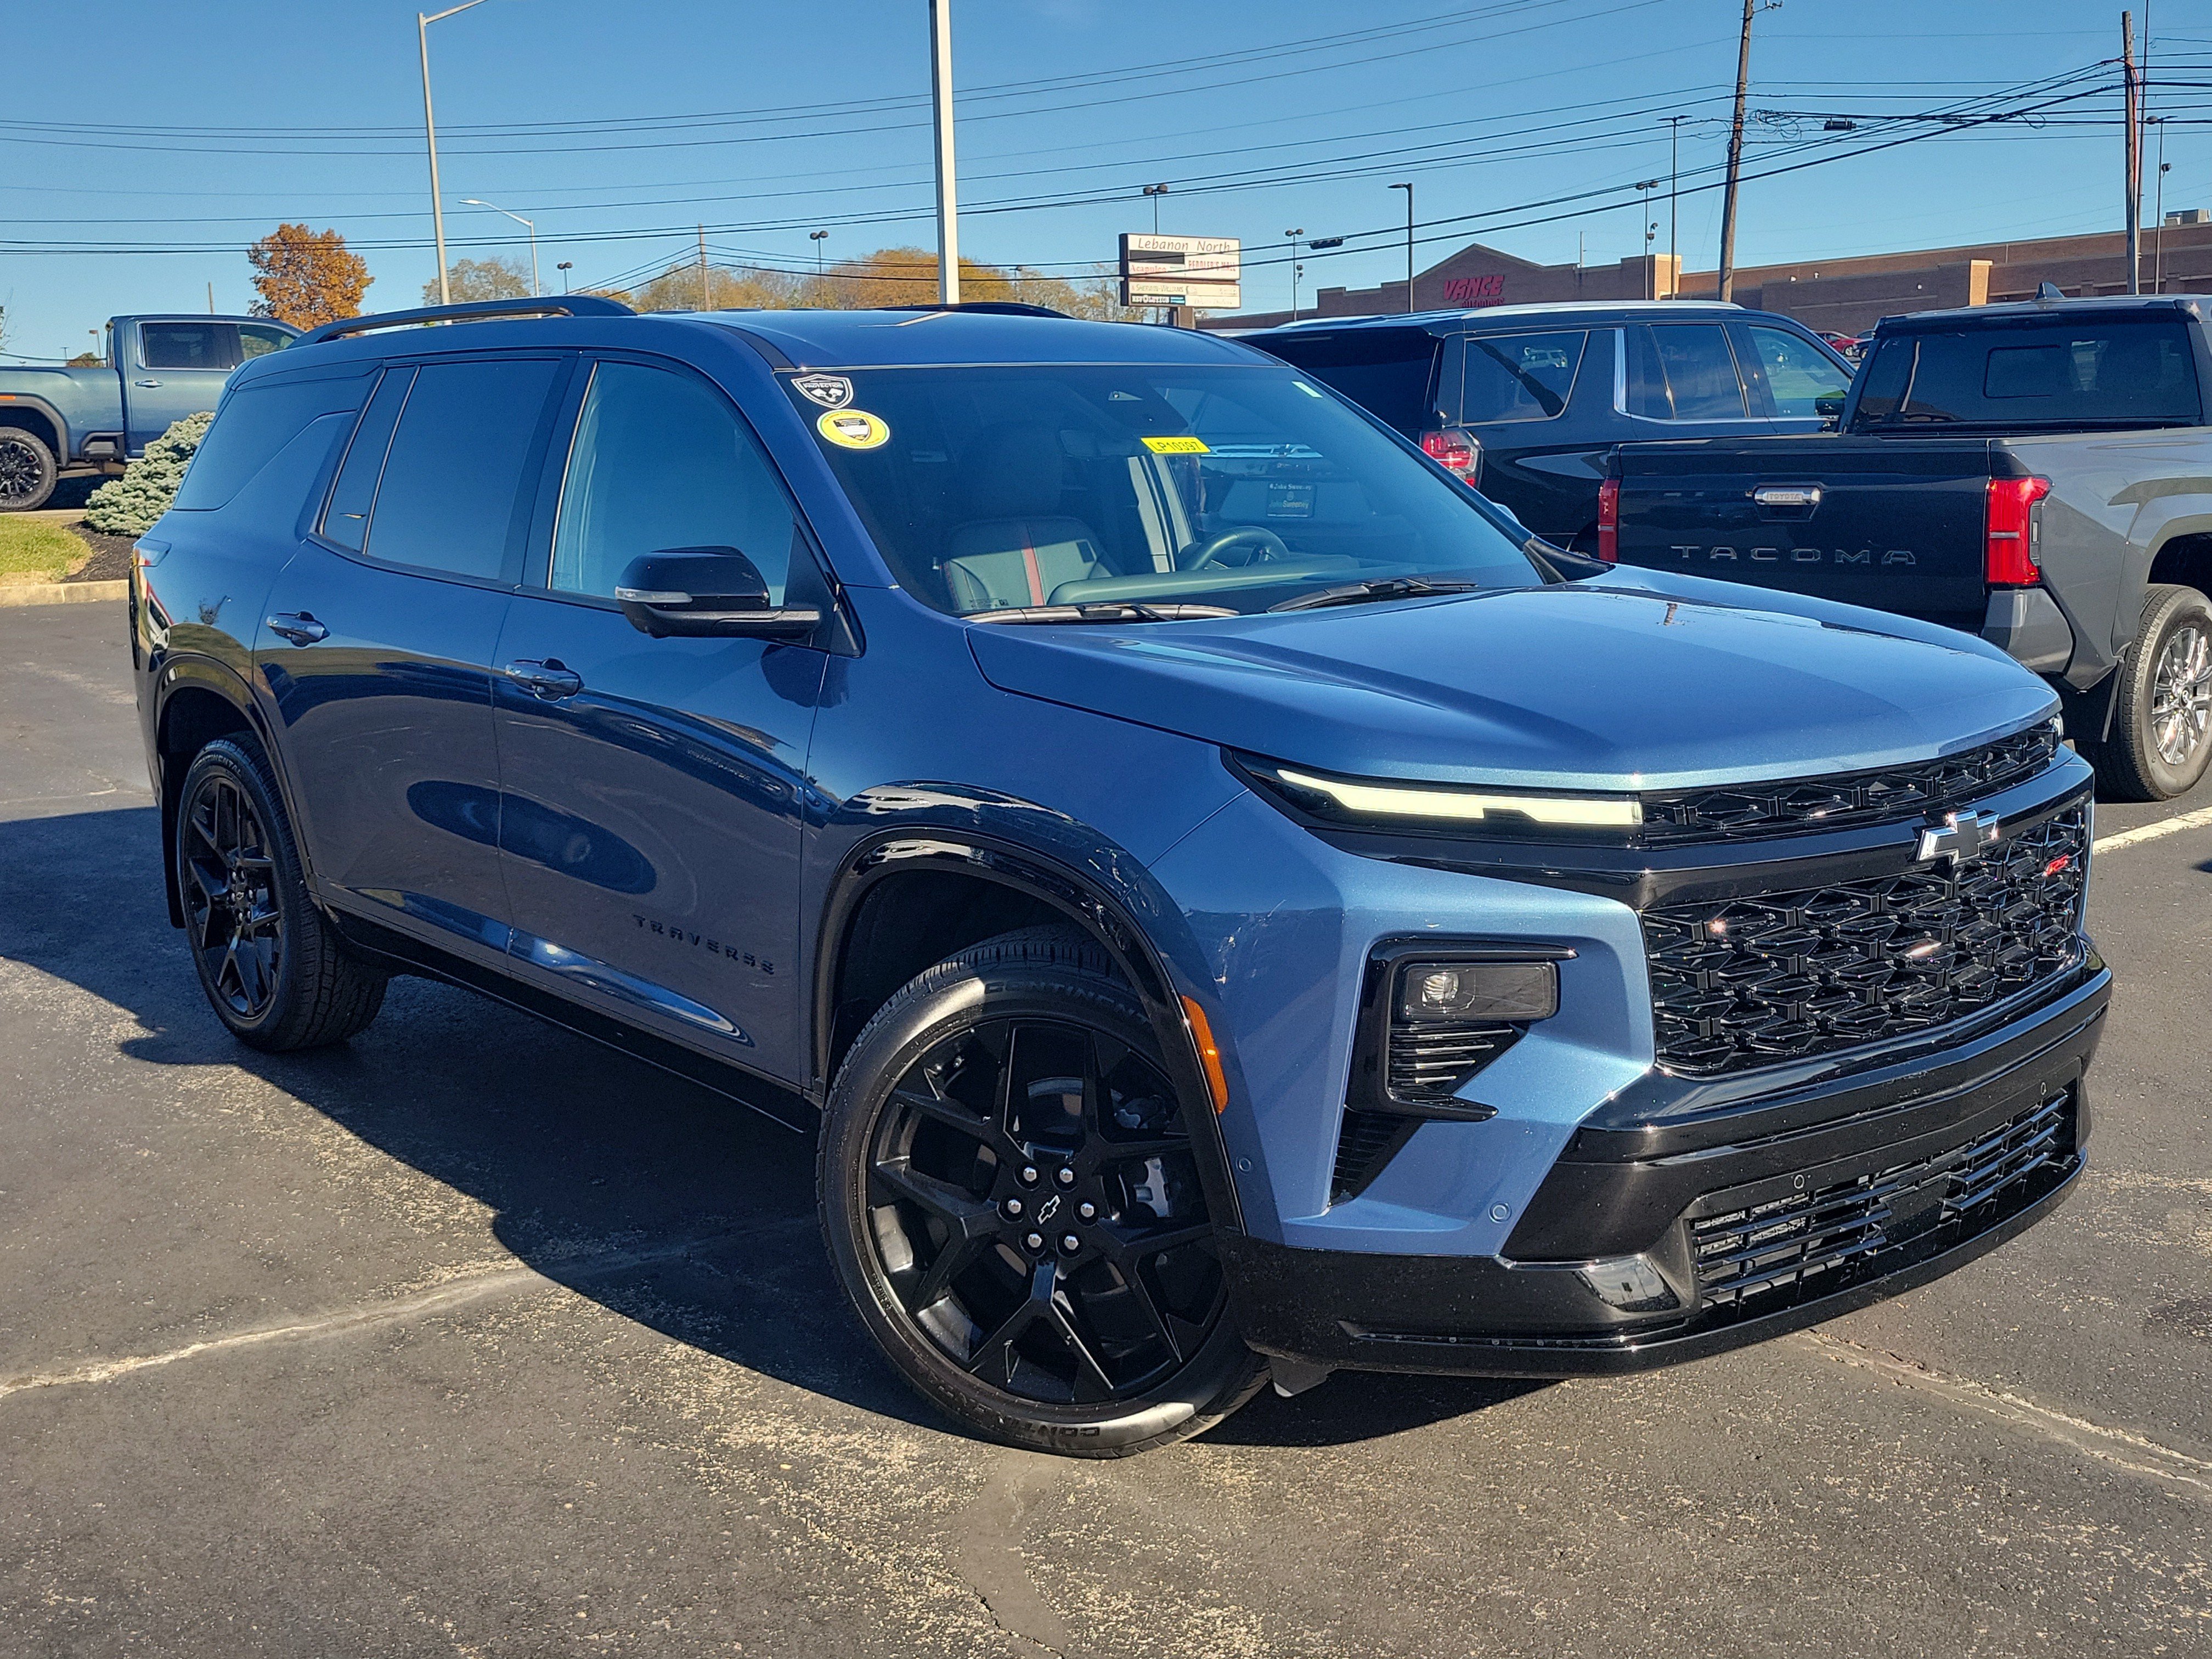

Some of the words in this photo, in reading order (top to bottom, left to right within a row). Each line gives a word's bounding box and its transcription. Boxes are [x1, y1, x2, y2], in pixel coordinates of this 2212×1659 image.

[1138, 238, 1188, 251] Lebanon
[1197, 241, 1230, 252] North
[1444, 275, 1504, 302] VANCE
[1149, 442, 1201, 452] LP10397
[1671, 546, 1916, 565] TACOMA
[633, 914, 775, 975] TRAVERSE
